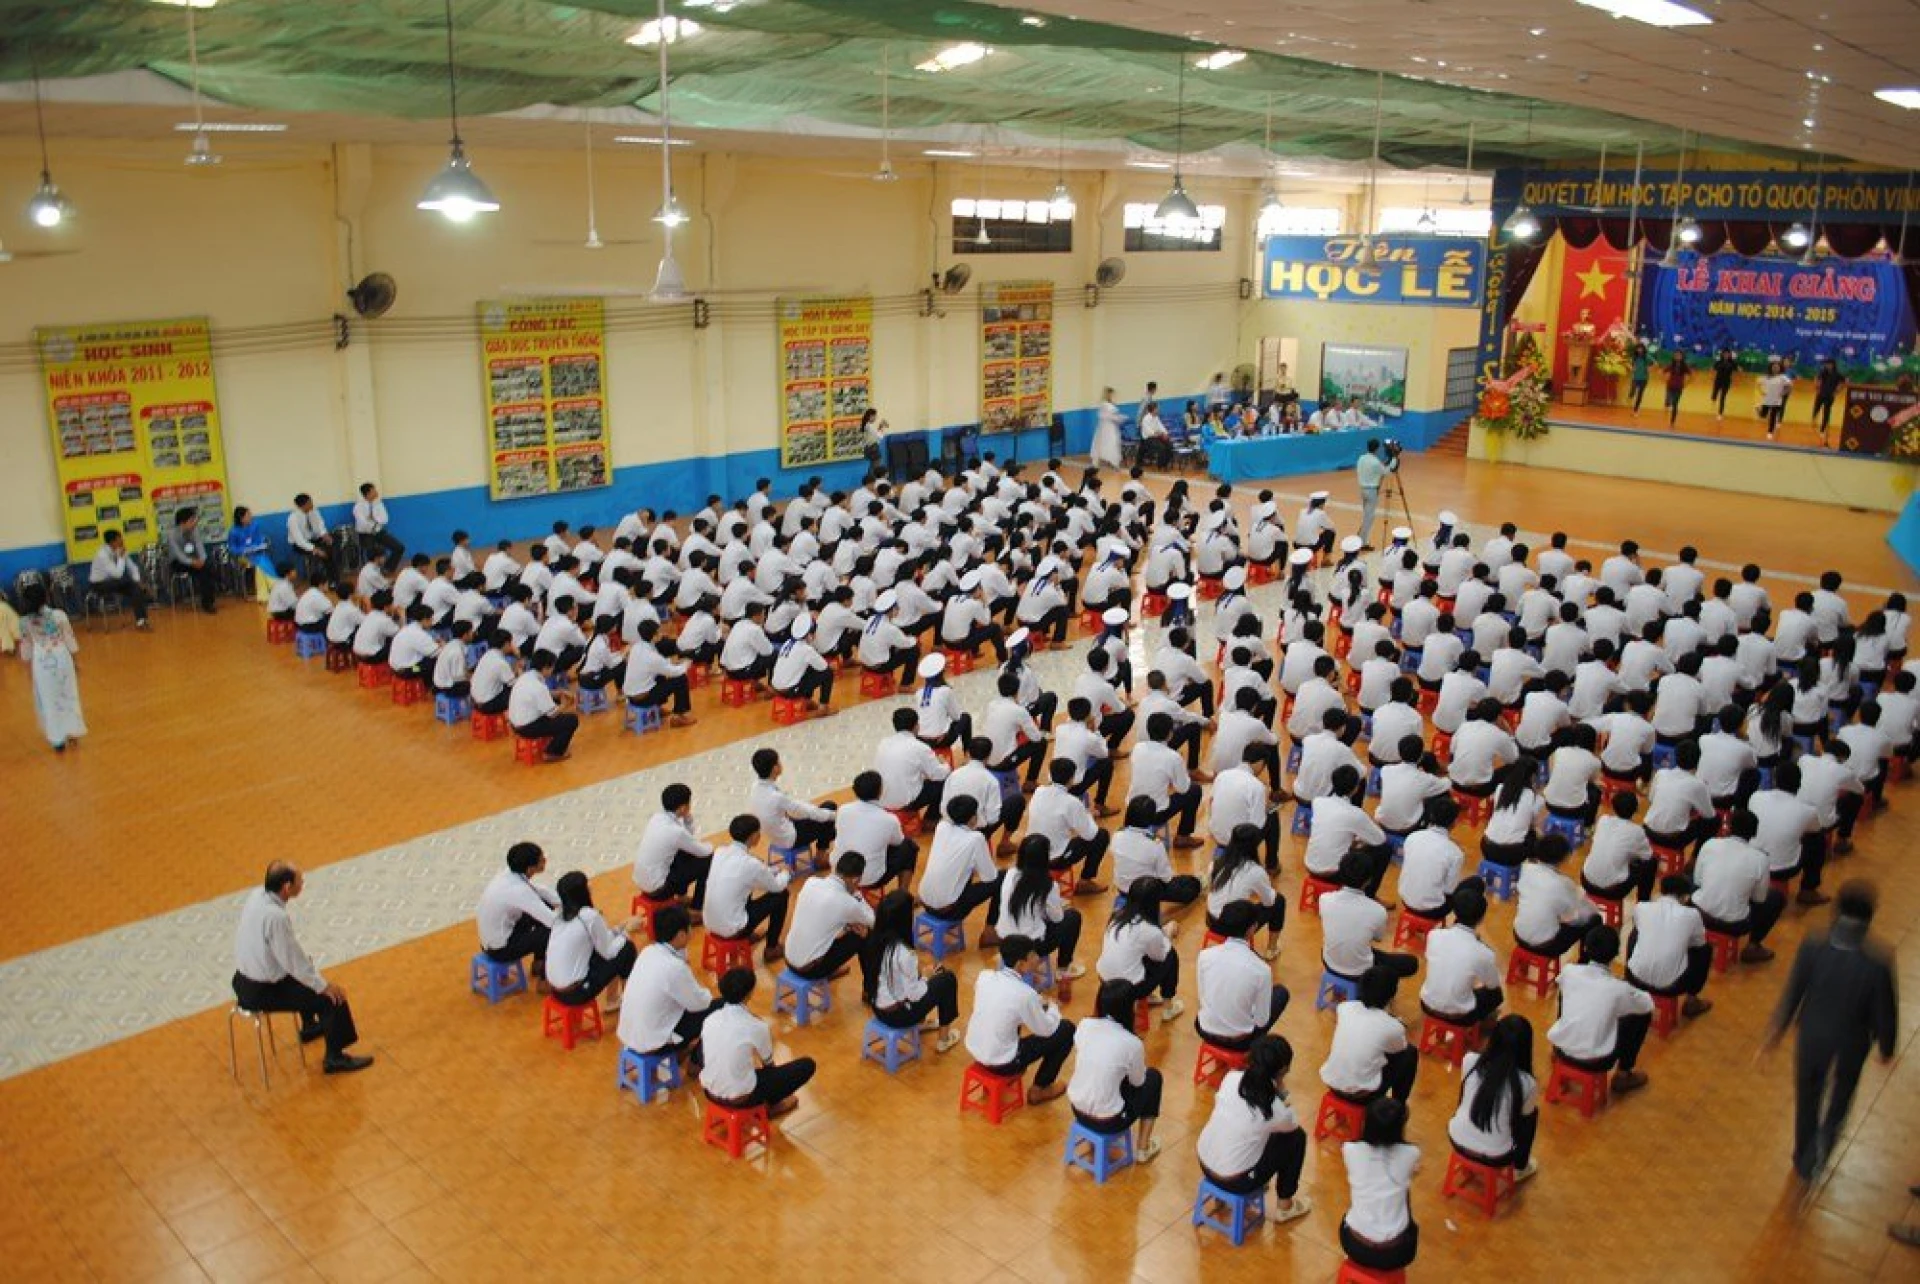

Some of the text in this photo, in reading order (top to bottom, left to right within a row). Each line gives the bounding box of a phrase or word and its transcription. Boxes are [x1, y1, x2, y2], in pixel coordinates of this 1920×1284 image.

[1695, 183, 1733, 209] CHO
[1270, 249, 1474, 301] HỌC LỄ
[1676, 257, 1876, 302] LỄ KHAI GIẢNG
[1708, 299, 1735, 317] NĂM
[1764, 304, 1795, 320] 2014
[1804, 306, 1837, 323] 2015
[83, 341, 174, 363] HỌC SINH
[131, 362, 164, 384] 2011
[177, 358, 211, 380] 2012
